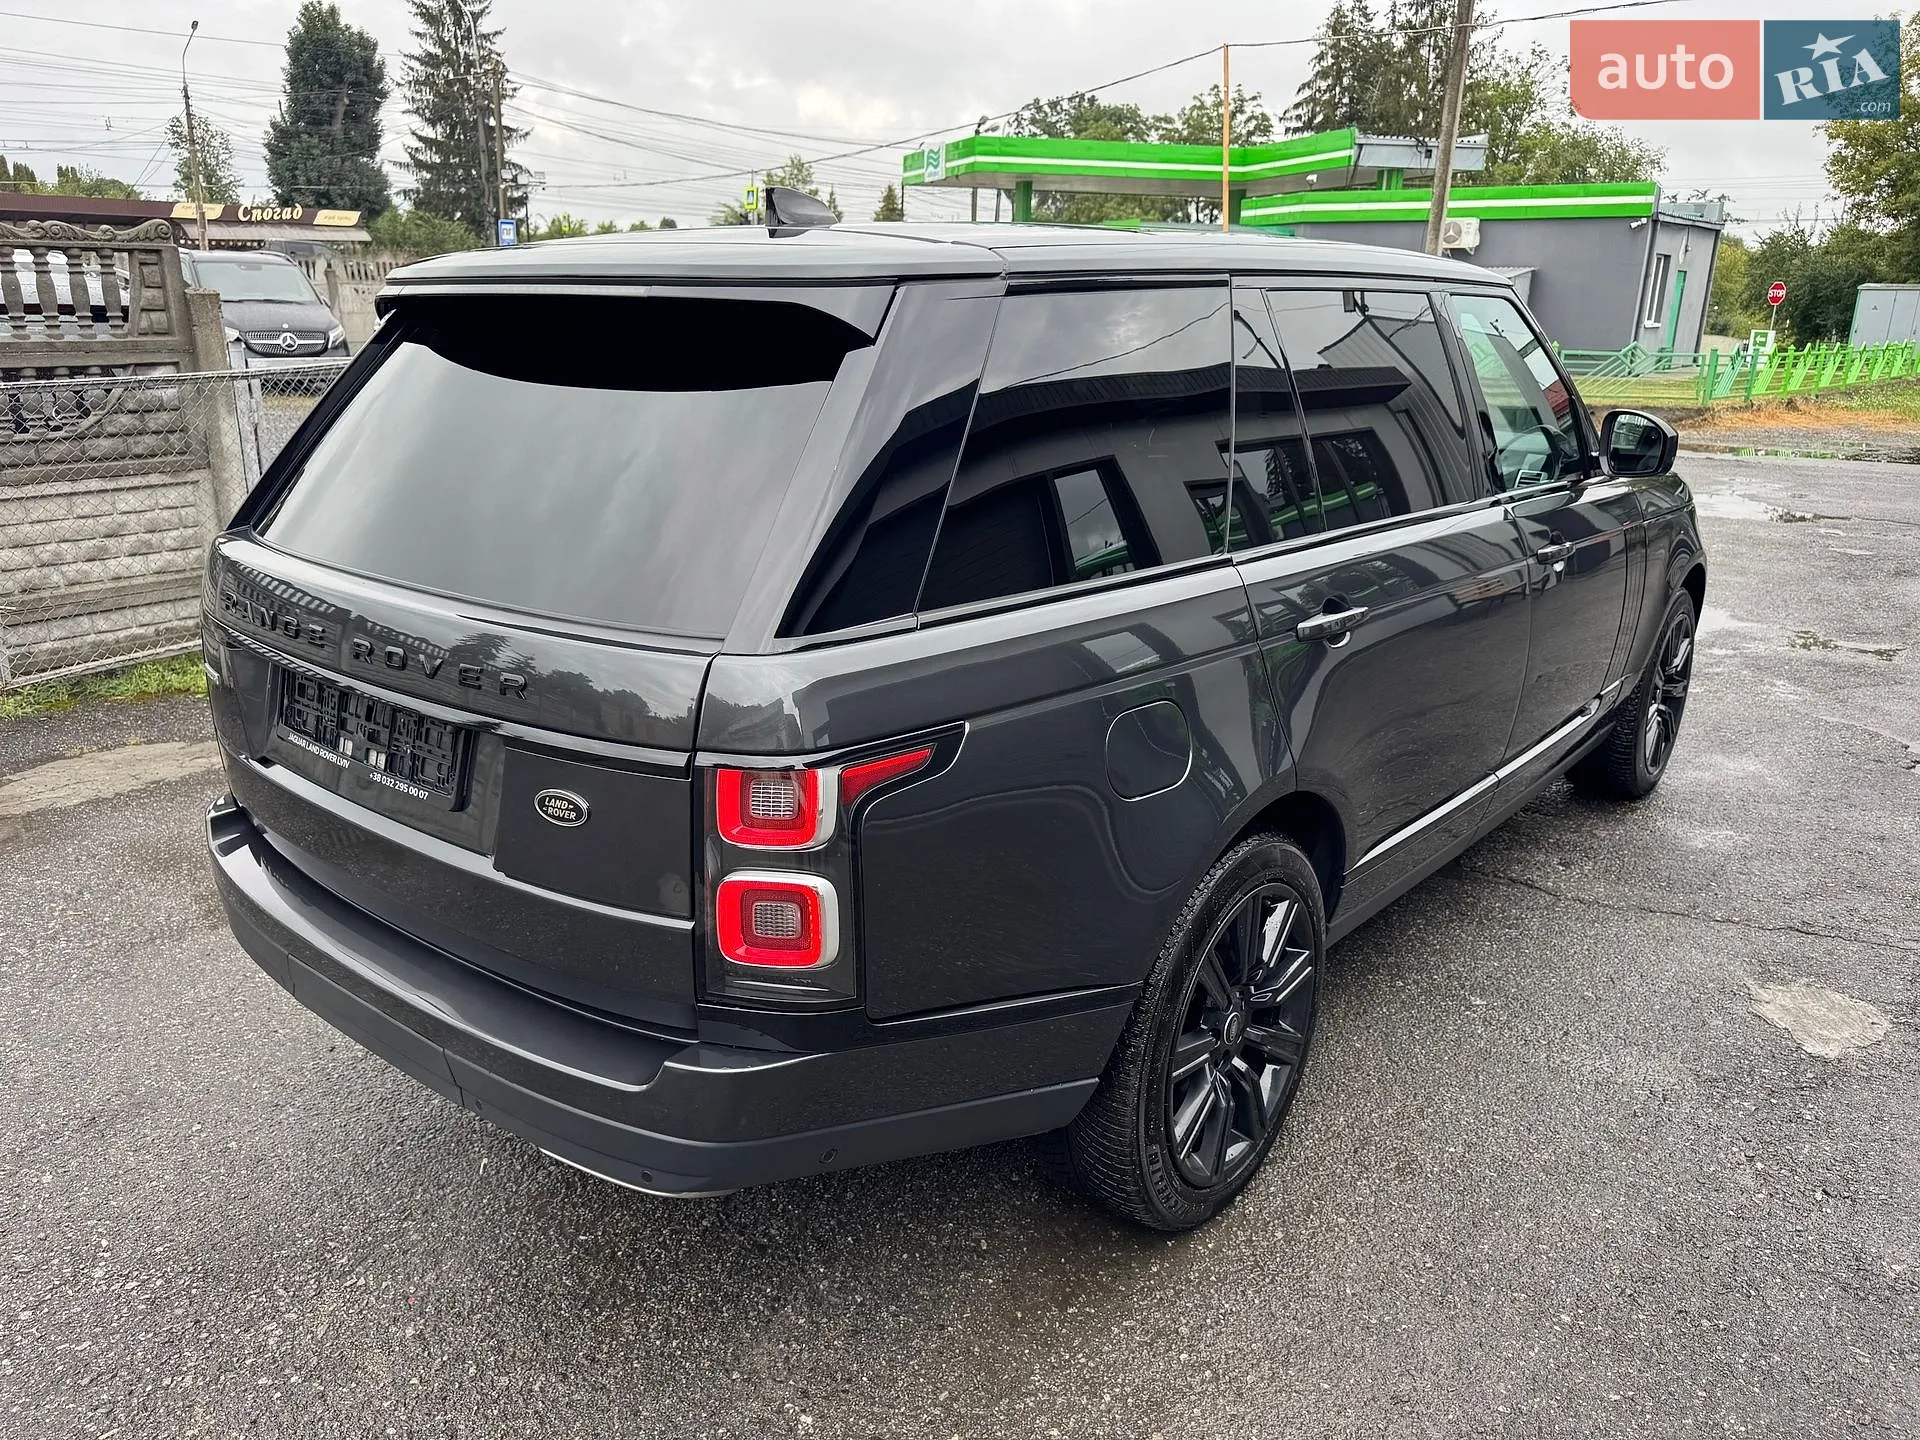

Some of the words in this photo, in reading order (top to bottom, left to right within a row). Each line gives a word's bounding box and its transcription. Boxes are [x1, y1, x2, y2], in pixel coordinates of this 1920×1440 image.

[237, 203, 303, 223] Спогад
[1768, 289, 1786, 298] STOP
[224, 591, 326, 648] RANGE
[352, 637, 528, 700] ROVER
[288, 732, 306, 749] JAGUAR
[305, 744, 320, 755] LAND
[319, 749, 338, 763] ROVER
[336, 757, 350, 769] LVIV
[369, 772, 381, 782] +38
[381, 776, 395, 788] 032
[394, 782, 409, 793] 295
[408, 786, 419, 797] 00
[418, 790, 429, 800] 07
[544, 797, 568, 809] LAND
[548, 806, 577, 820] ROVER
